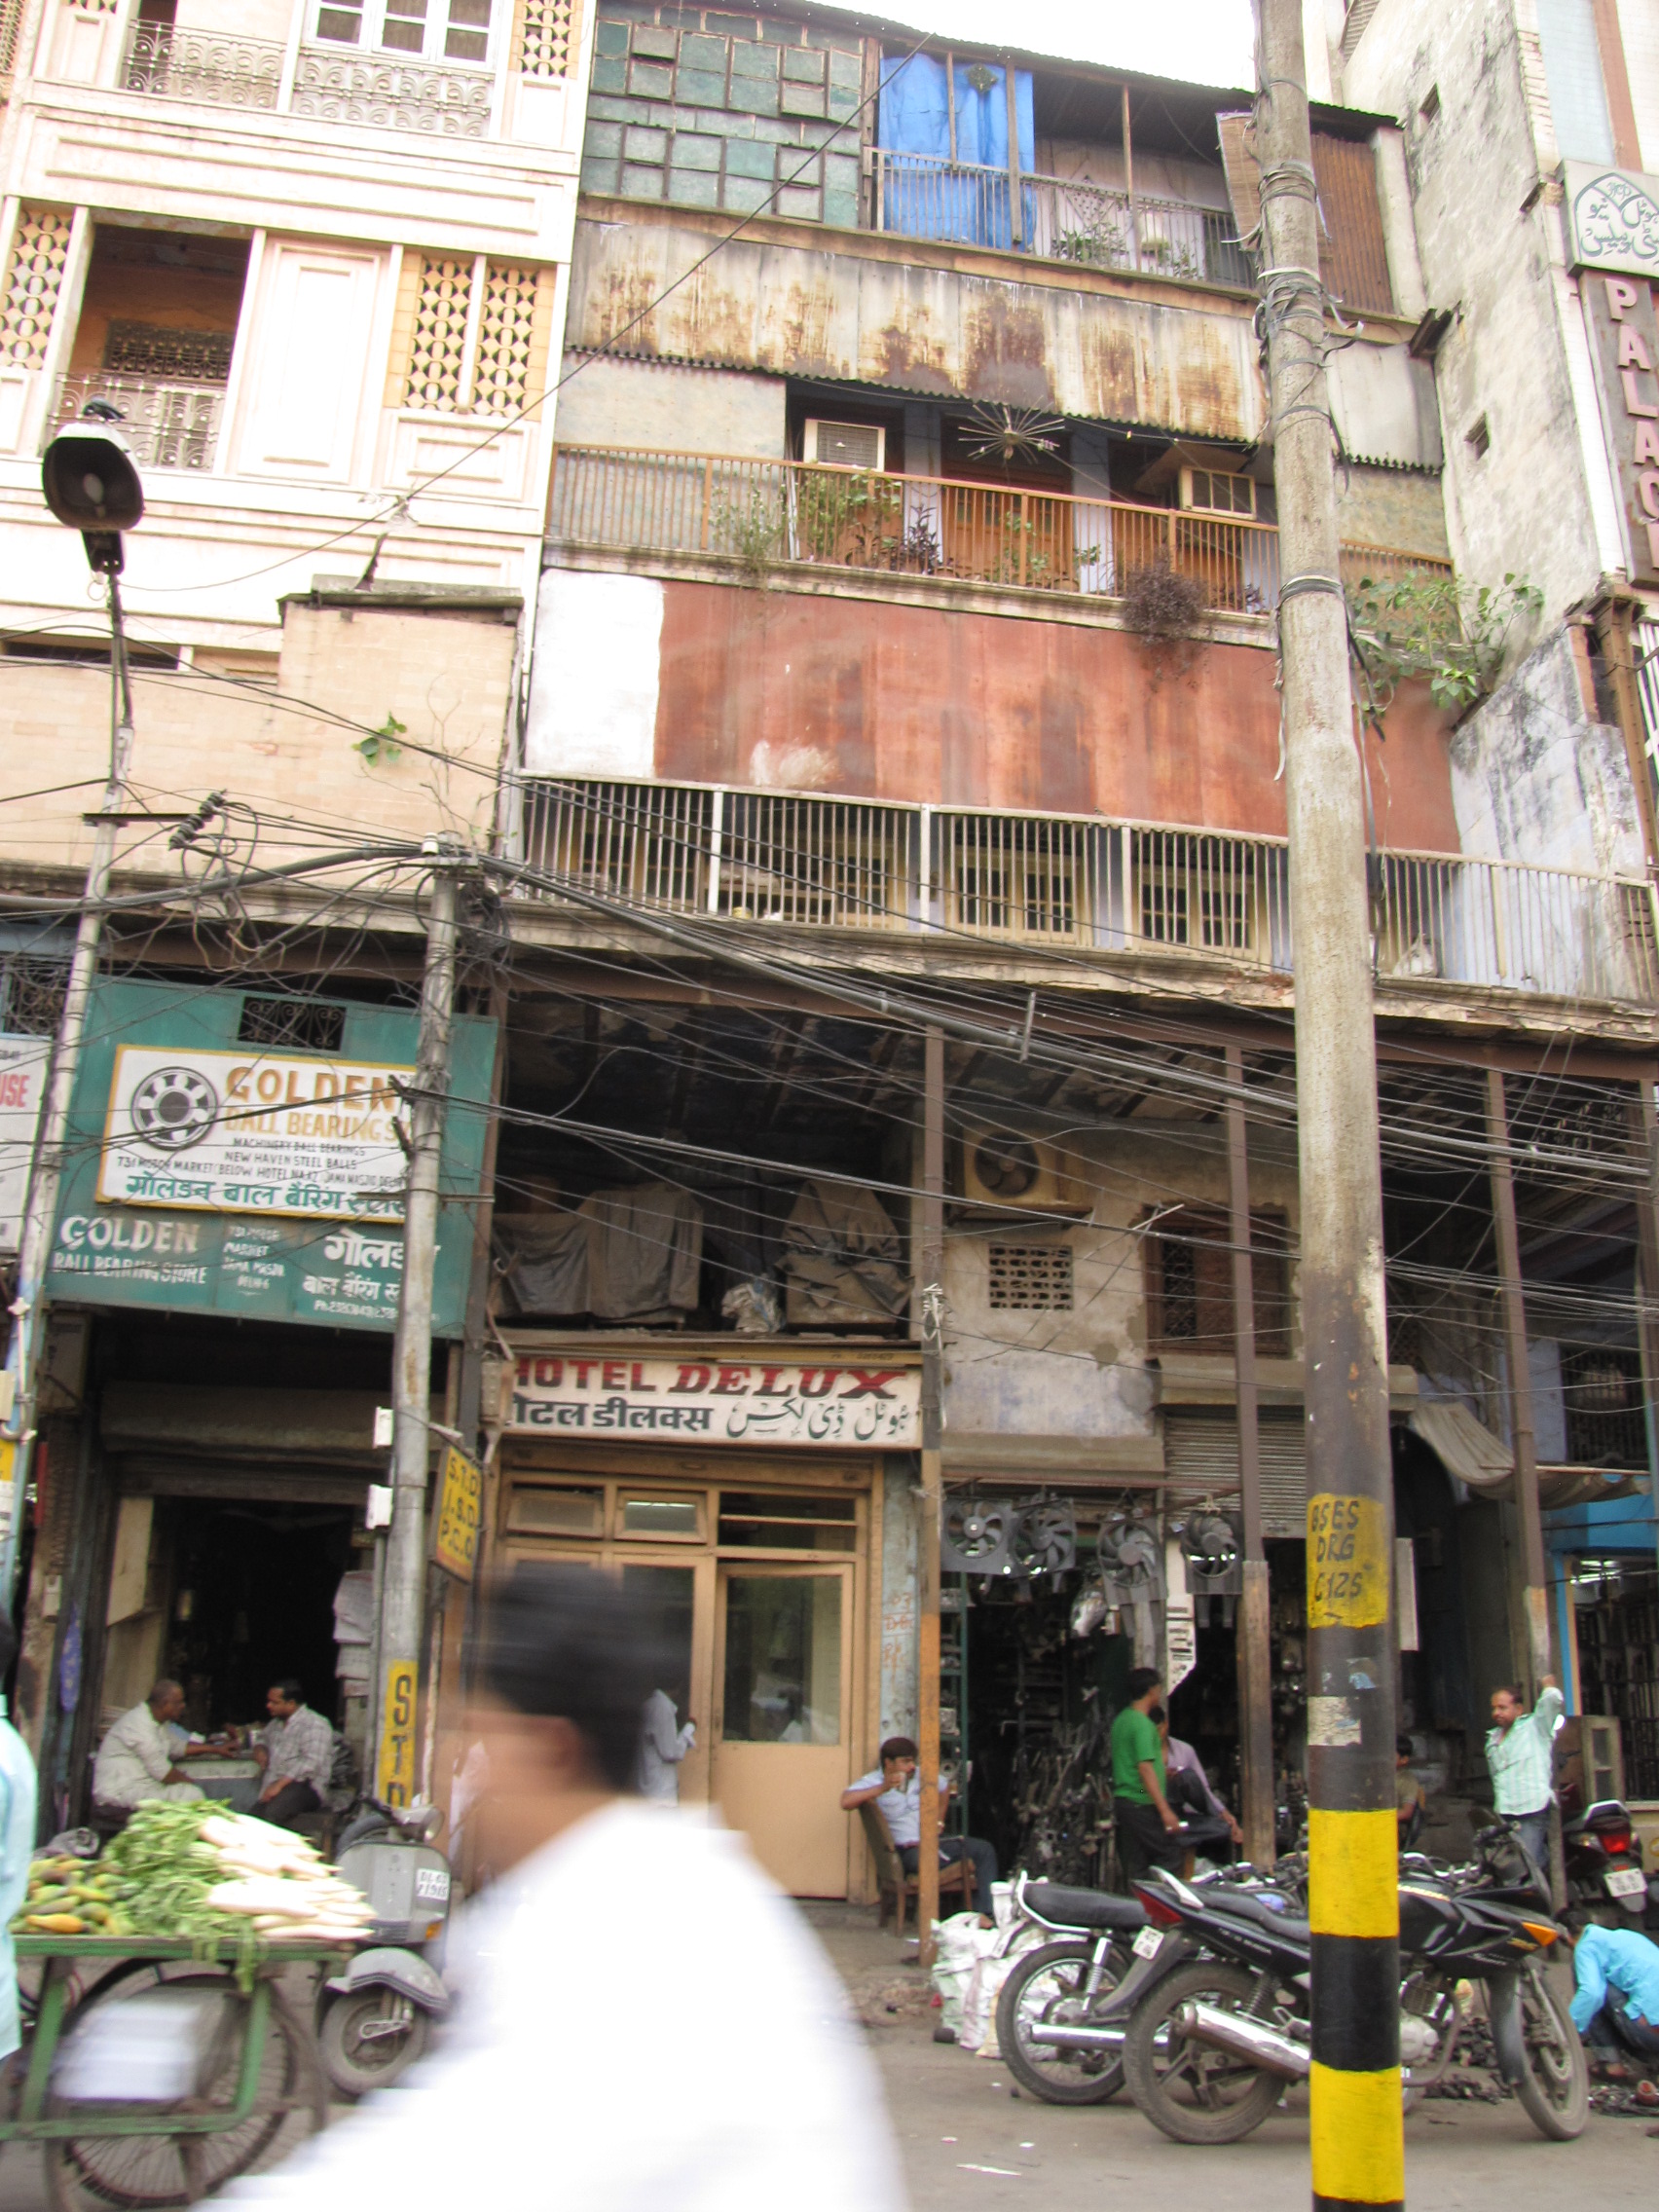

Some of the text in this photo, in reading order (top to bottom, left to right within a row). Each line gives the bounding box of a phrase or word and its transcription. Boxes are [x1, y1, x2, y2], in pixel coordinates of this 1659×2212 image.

[226, 1066, 396, 1113] GOLDEN
[224, 1107, 281, 1135] BALL
[286, 1111, 383, 1141] BEARING
[173, 1161, 212, 1173] MARKET
[256, 1166, 286, 1180] HOTEL
[224, 1151, 357, 1170] NEW HAVEN STEEL BALLS
[60, 1215, 201, 1254] GOLDEN
[52, 1252, 91, 1274] BALL
[160, 1263, 209, 1285] STORE
[667, 1364, 906, 1399] DELUX
[592, 1396, 715, 1432] डीलक्स
[1316, 1533, 1355, 1563] DRG
